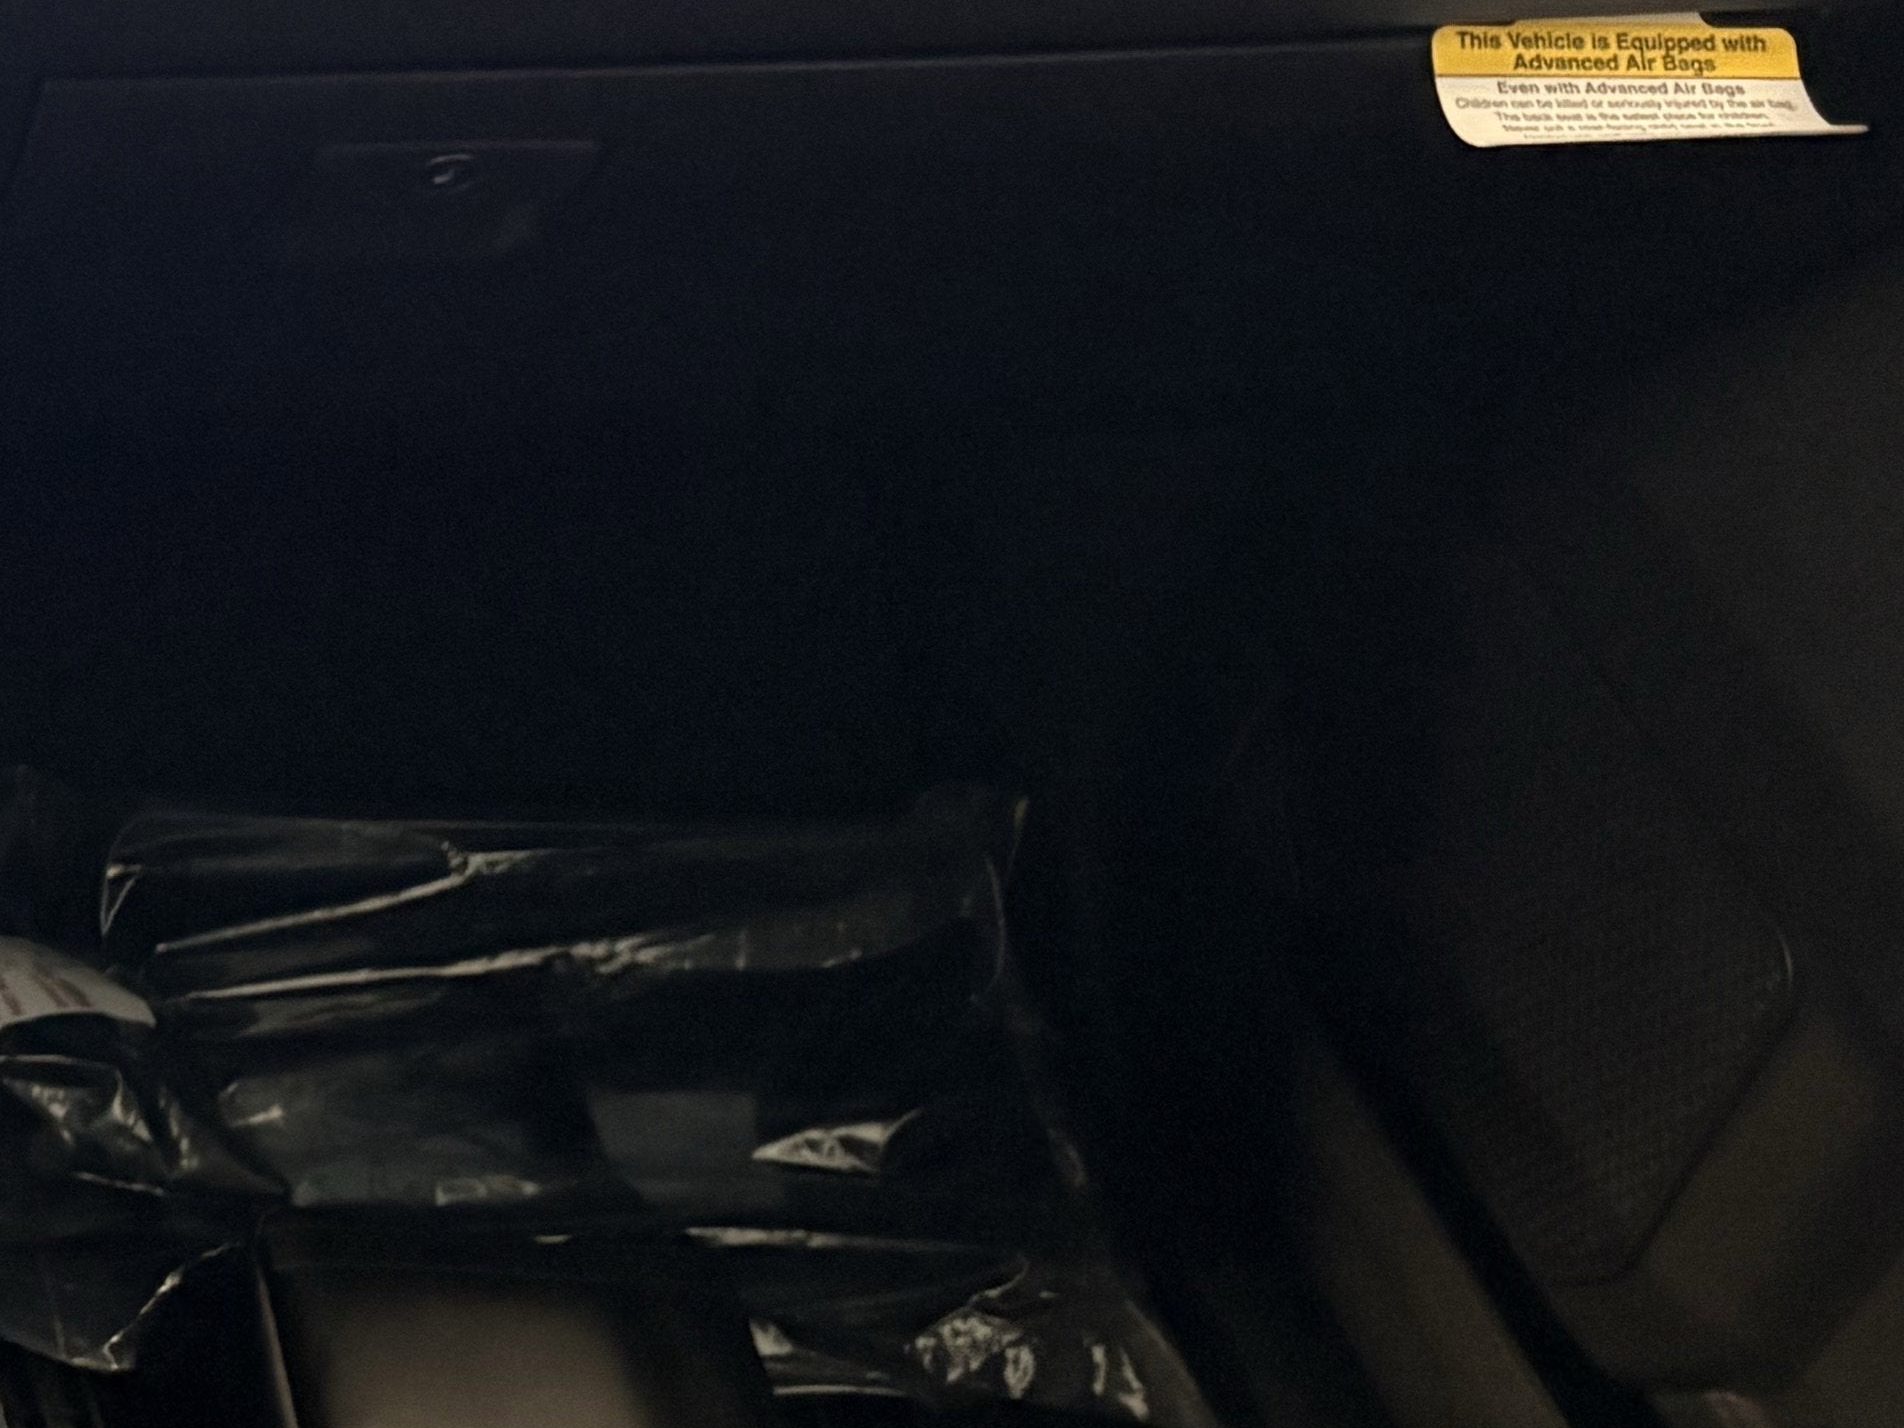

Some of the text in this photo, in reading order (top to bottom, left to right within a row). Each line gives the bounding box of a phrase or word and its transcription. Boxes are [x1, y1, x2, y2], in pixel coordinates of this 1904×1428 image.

[1457, 31, 1767, 56] This Vehicle is Equipped with
[1514, 53, 1716, 76] Advanced Air Bags
[1497, 81, 1746, 97] Even with Advanced Air Bags
[1537, 98, 1553, 109] be
